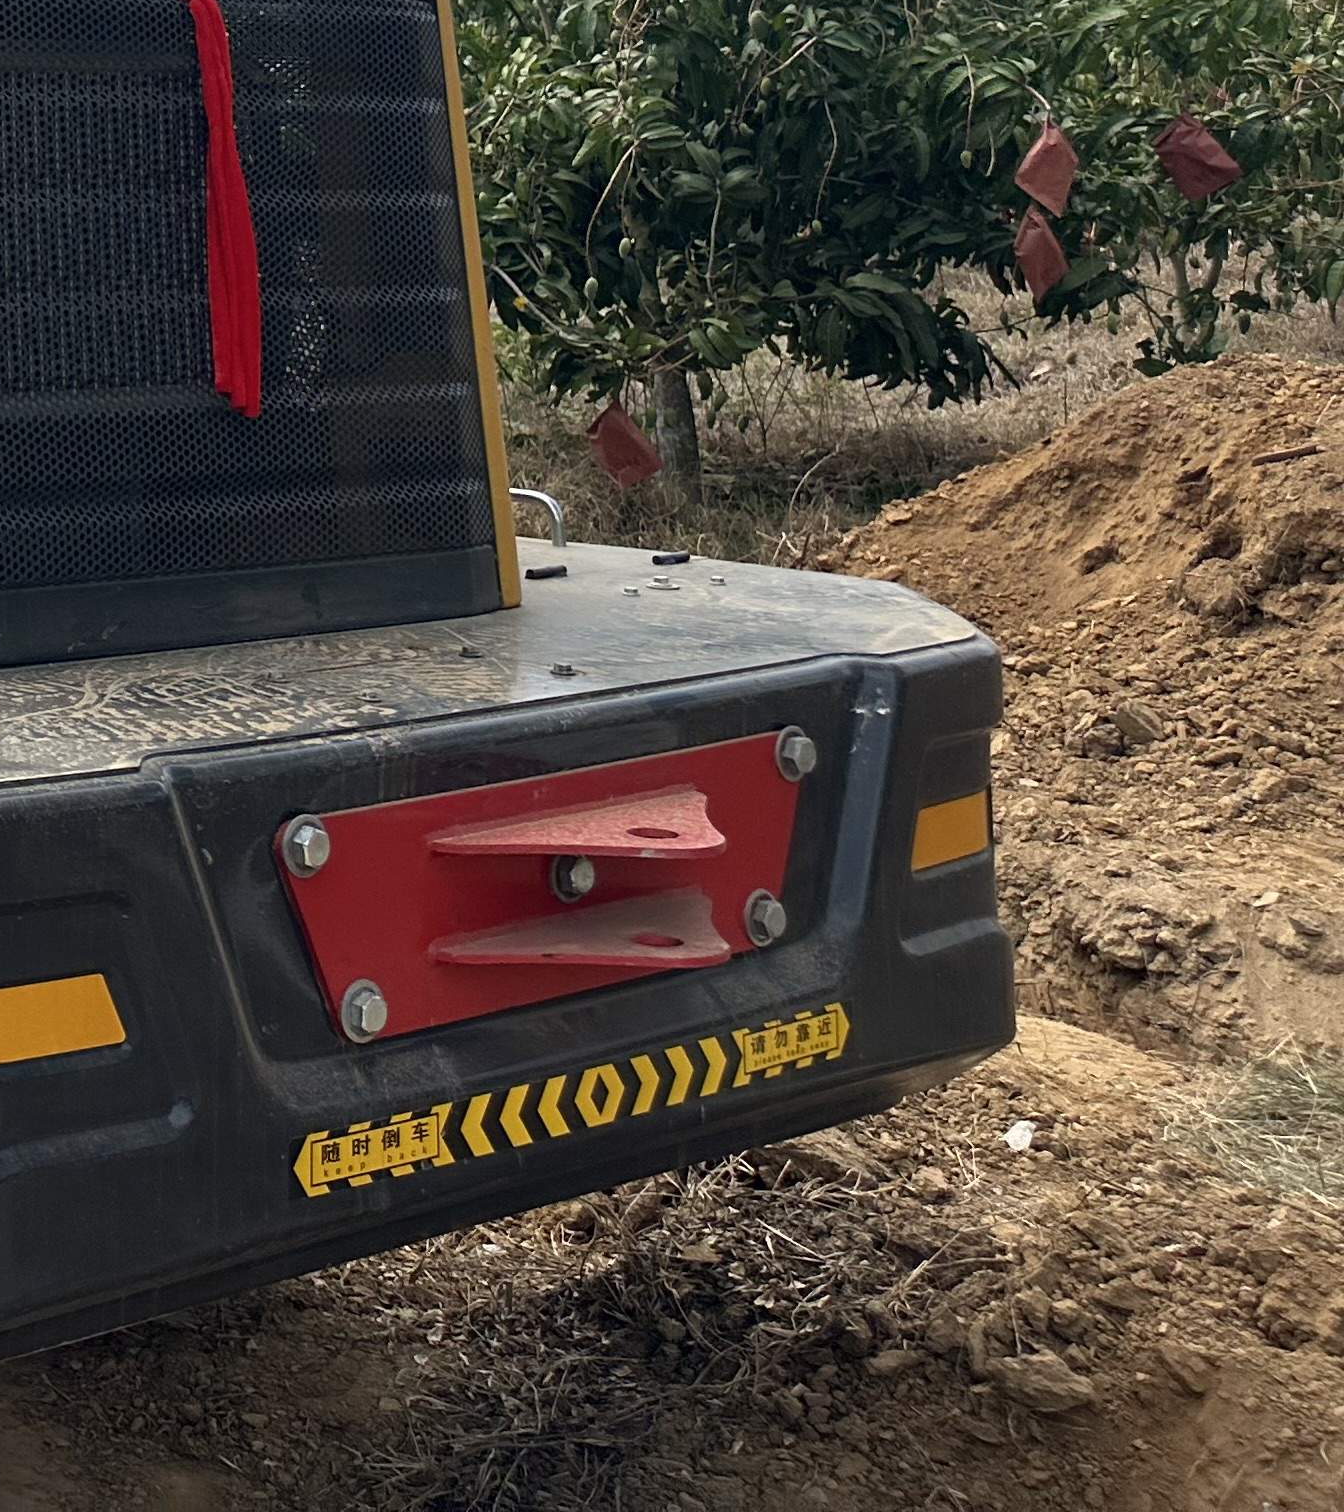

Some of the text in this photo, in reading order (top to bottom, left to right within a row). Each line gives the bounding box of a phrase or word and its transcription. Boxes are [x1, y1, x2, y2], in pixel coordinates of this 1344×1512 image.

[750, 1017, 833, 1055] 请勿靠近
[321, 1121, 430, 1165] 随时倒车
[323, 1146, 428, 1178] keep back
